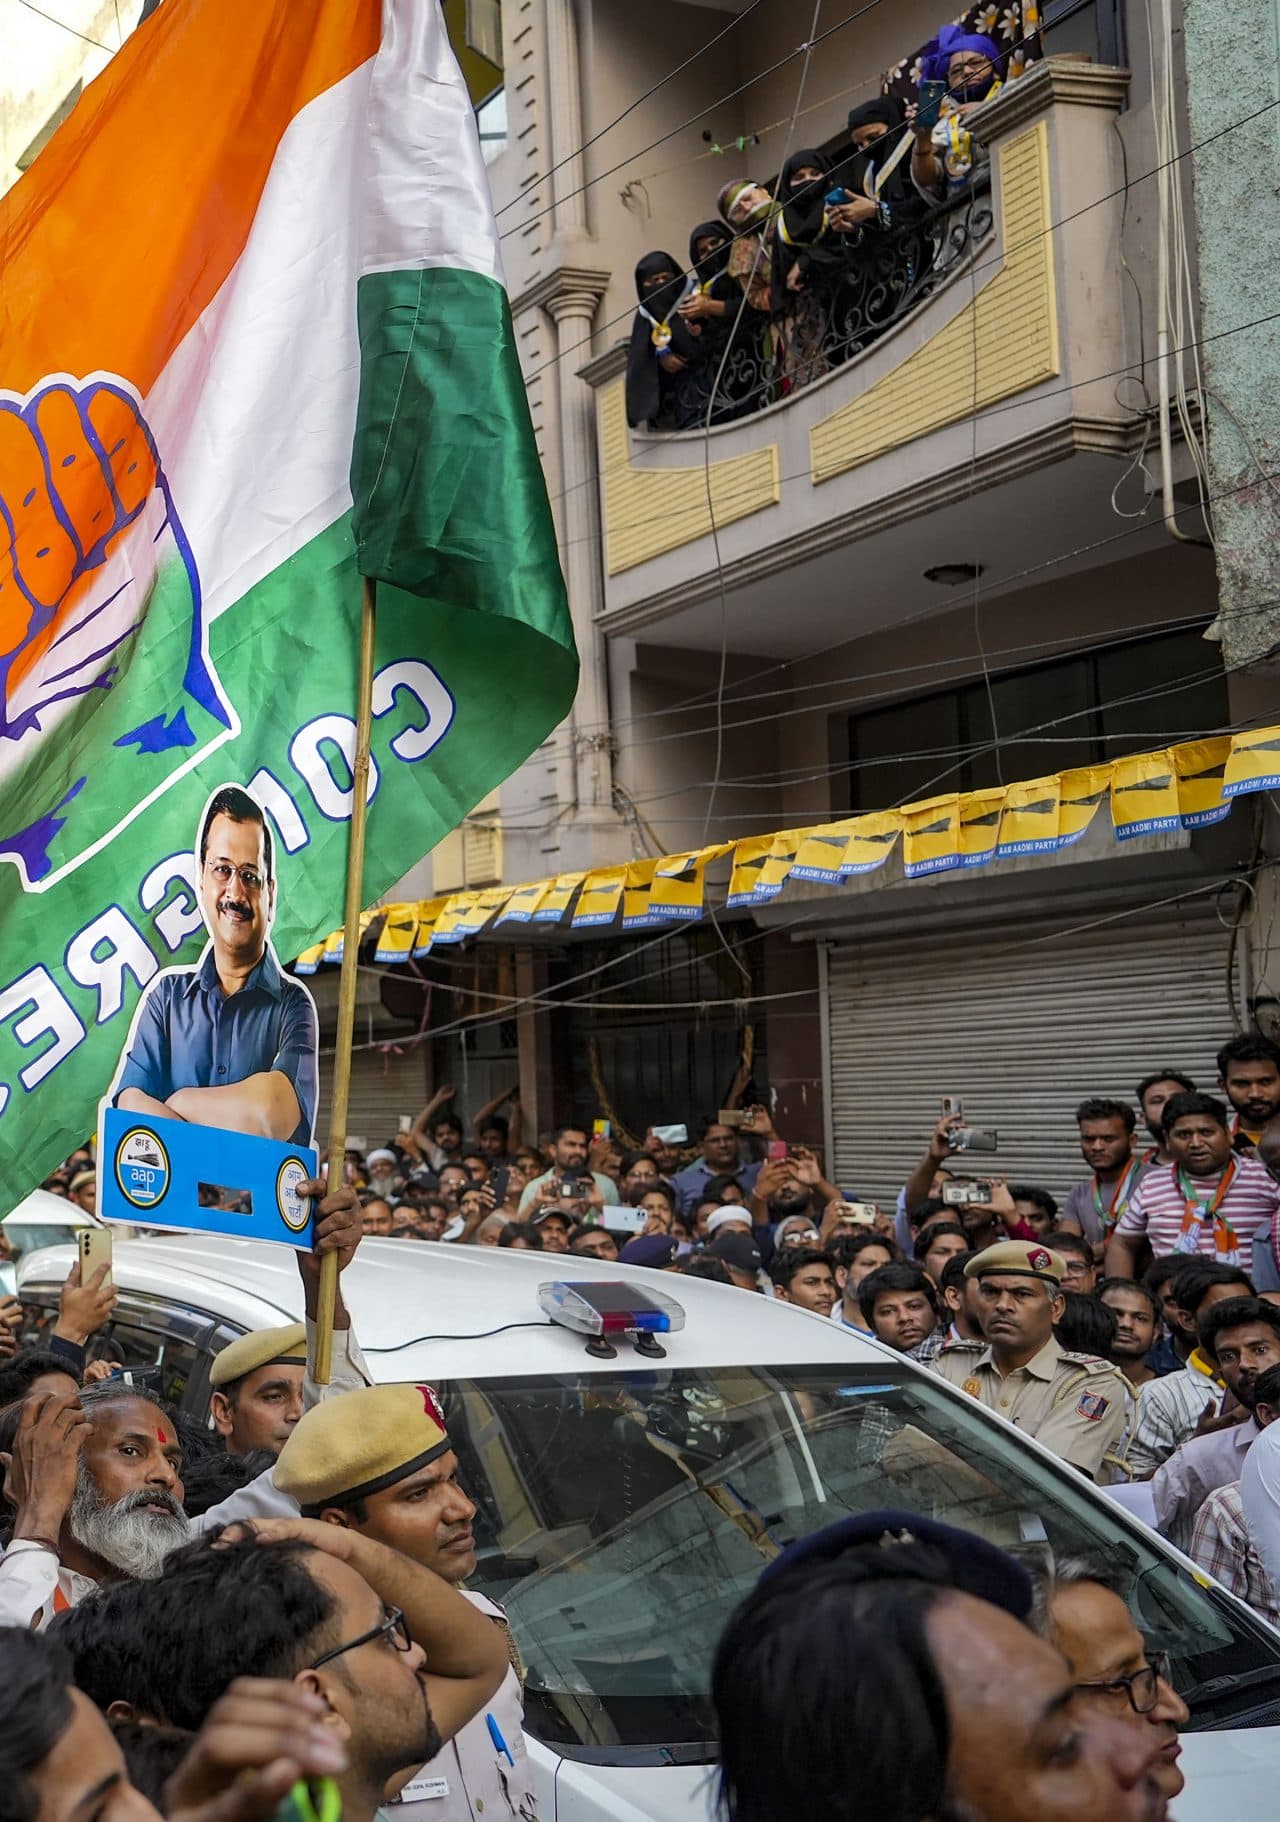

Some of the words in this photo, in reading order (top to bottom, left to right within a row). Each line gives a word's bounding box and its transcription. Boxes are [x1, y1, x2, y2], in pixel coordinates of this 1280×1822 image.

[1223, 785, 1239, 795] AAM
[1239, 779, 1261, 791] AADMI
[1118, 825, 1131, 837] AAM
[1131, 822, 1152, 833] AADMI
[1153, 818, 1178, 830] PARTY
[1184, 815, 1200, 826] AAM
[999, 846, 1012, 855] AAM
[1012, 843, 1034, 853] AADMI
[1034, 840, 1058, 851] PARTY
[916, 860, 935, 872] AADMI
[934, 856, 955, 868] PARTY
[801, 869, 821, 878] AADMI
[821, 872, 841, 882] PARTY
[660, 906, 678, 915] AADMI
[679, 907, 698, 916] PARTY
[131, 1168, 155, 1192] aap
